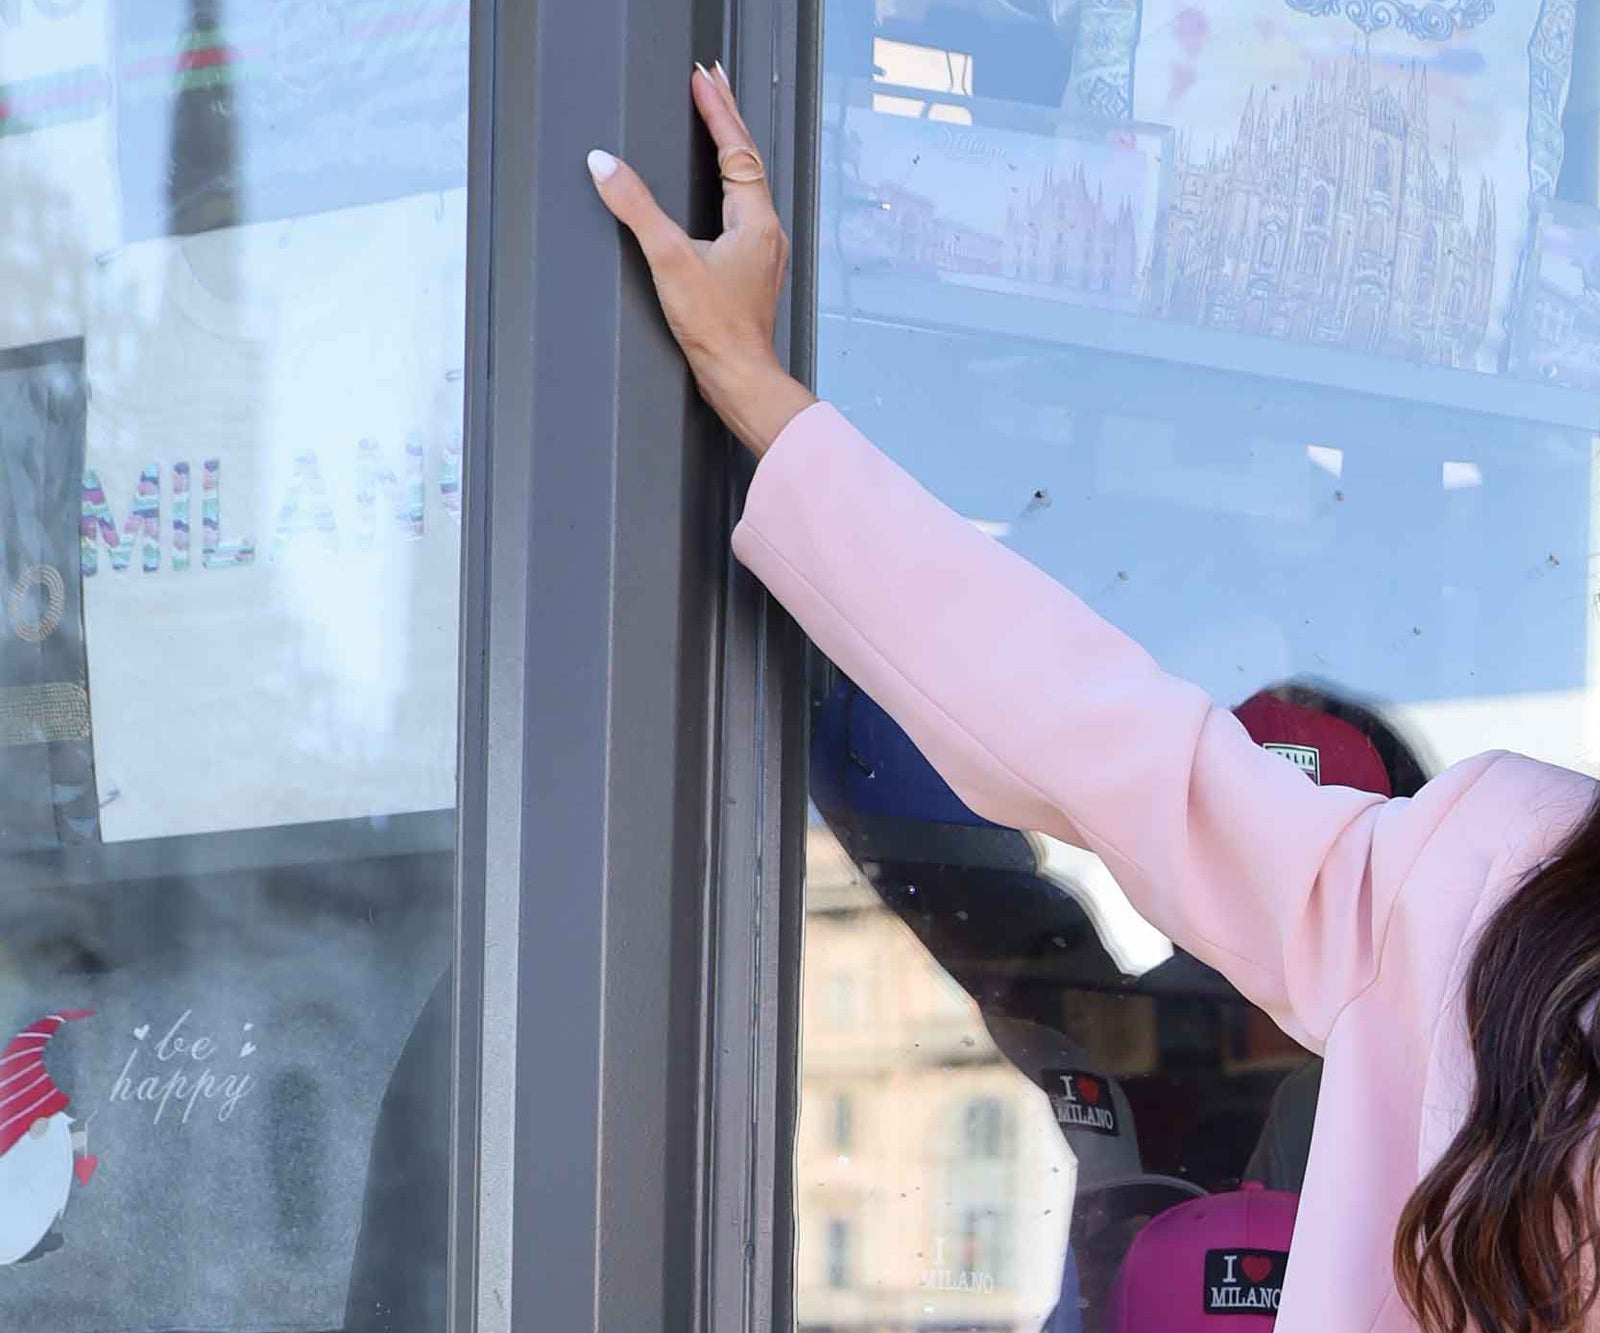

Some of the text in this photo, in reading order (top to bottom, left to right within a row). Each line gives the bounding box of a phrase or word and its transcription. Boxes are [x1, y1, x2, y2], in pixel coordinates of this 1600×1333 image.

[154, 1008, 217, 1062] be
[109, 1047, 257, 1125] happy
[1059, 1074, 1078, 1102] I
[1058, 1104, 1115, 1130] MILANO
[1222, 1254, 1238, 1284] I
